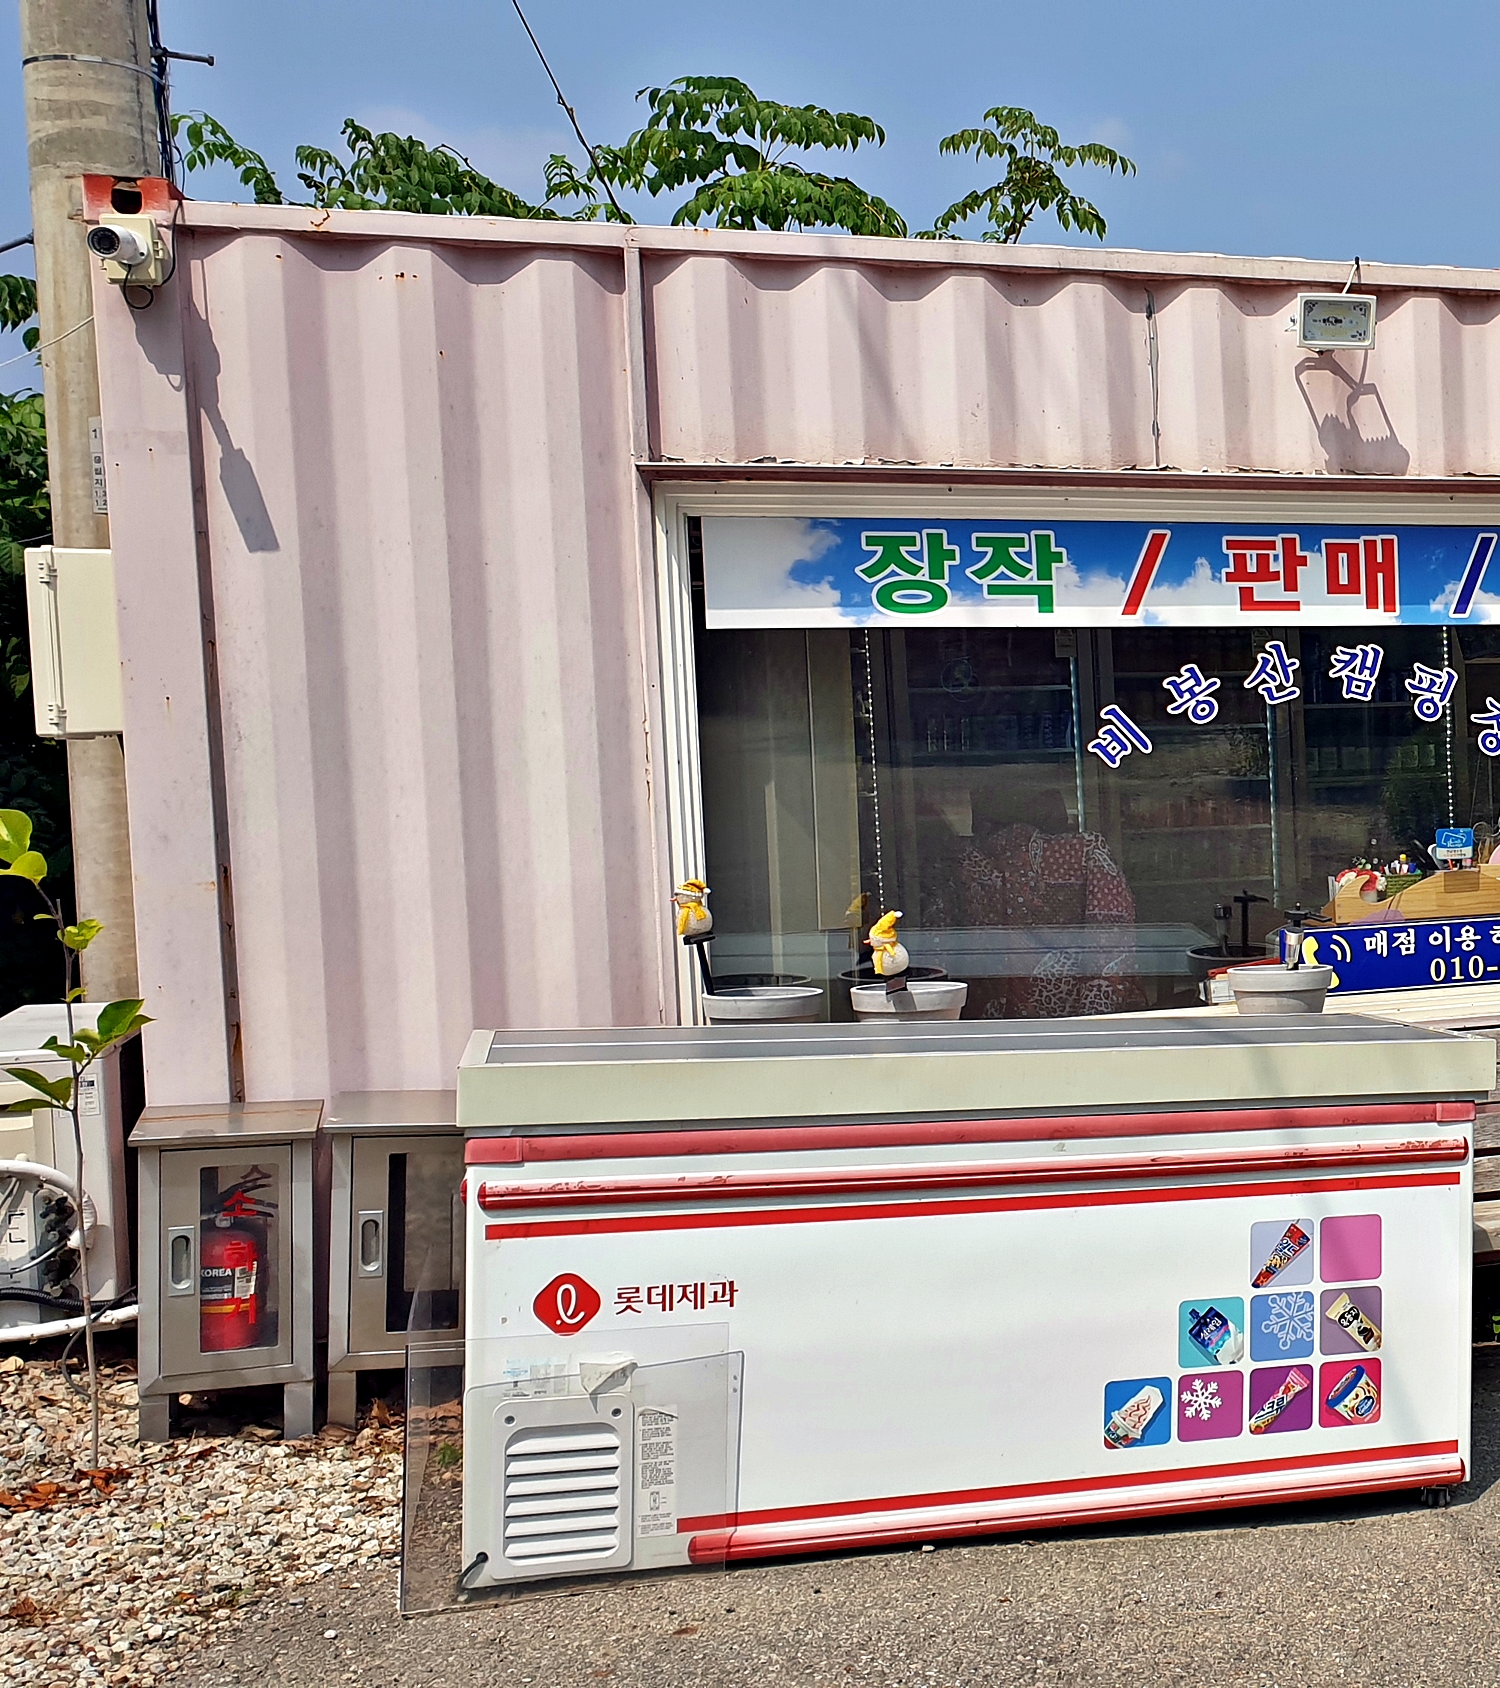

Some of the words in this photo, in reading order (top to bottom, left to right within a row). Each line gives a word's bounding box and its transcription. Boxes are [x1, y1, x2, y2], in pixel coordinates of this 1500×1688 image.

[857, 530, 1067, 615] 장작
[1223, 534, 1400, 614] 판매
[1364, 928, 1416, 957] 매점
[1429, 925, 1481, 953] 이용
[614, 1281, 739, 1315] 롯데제과
